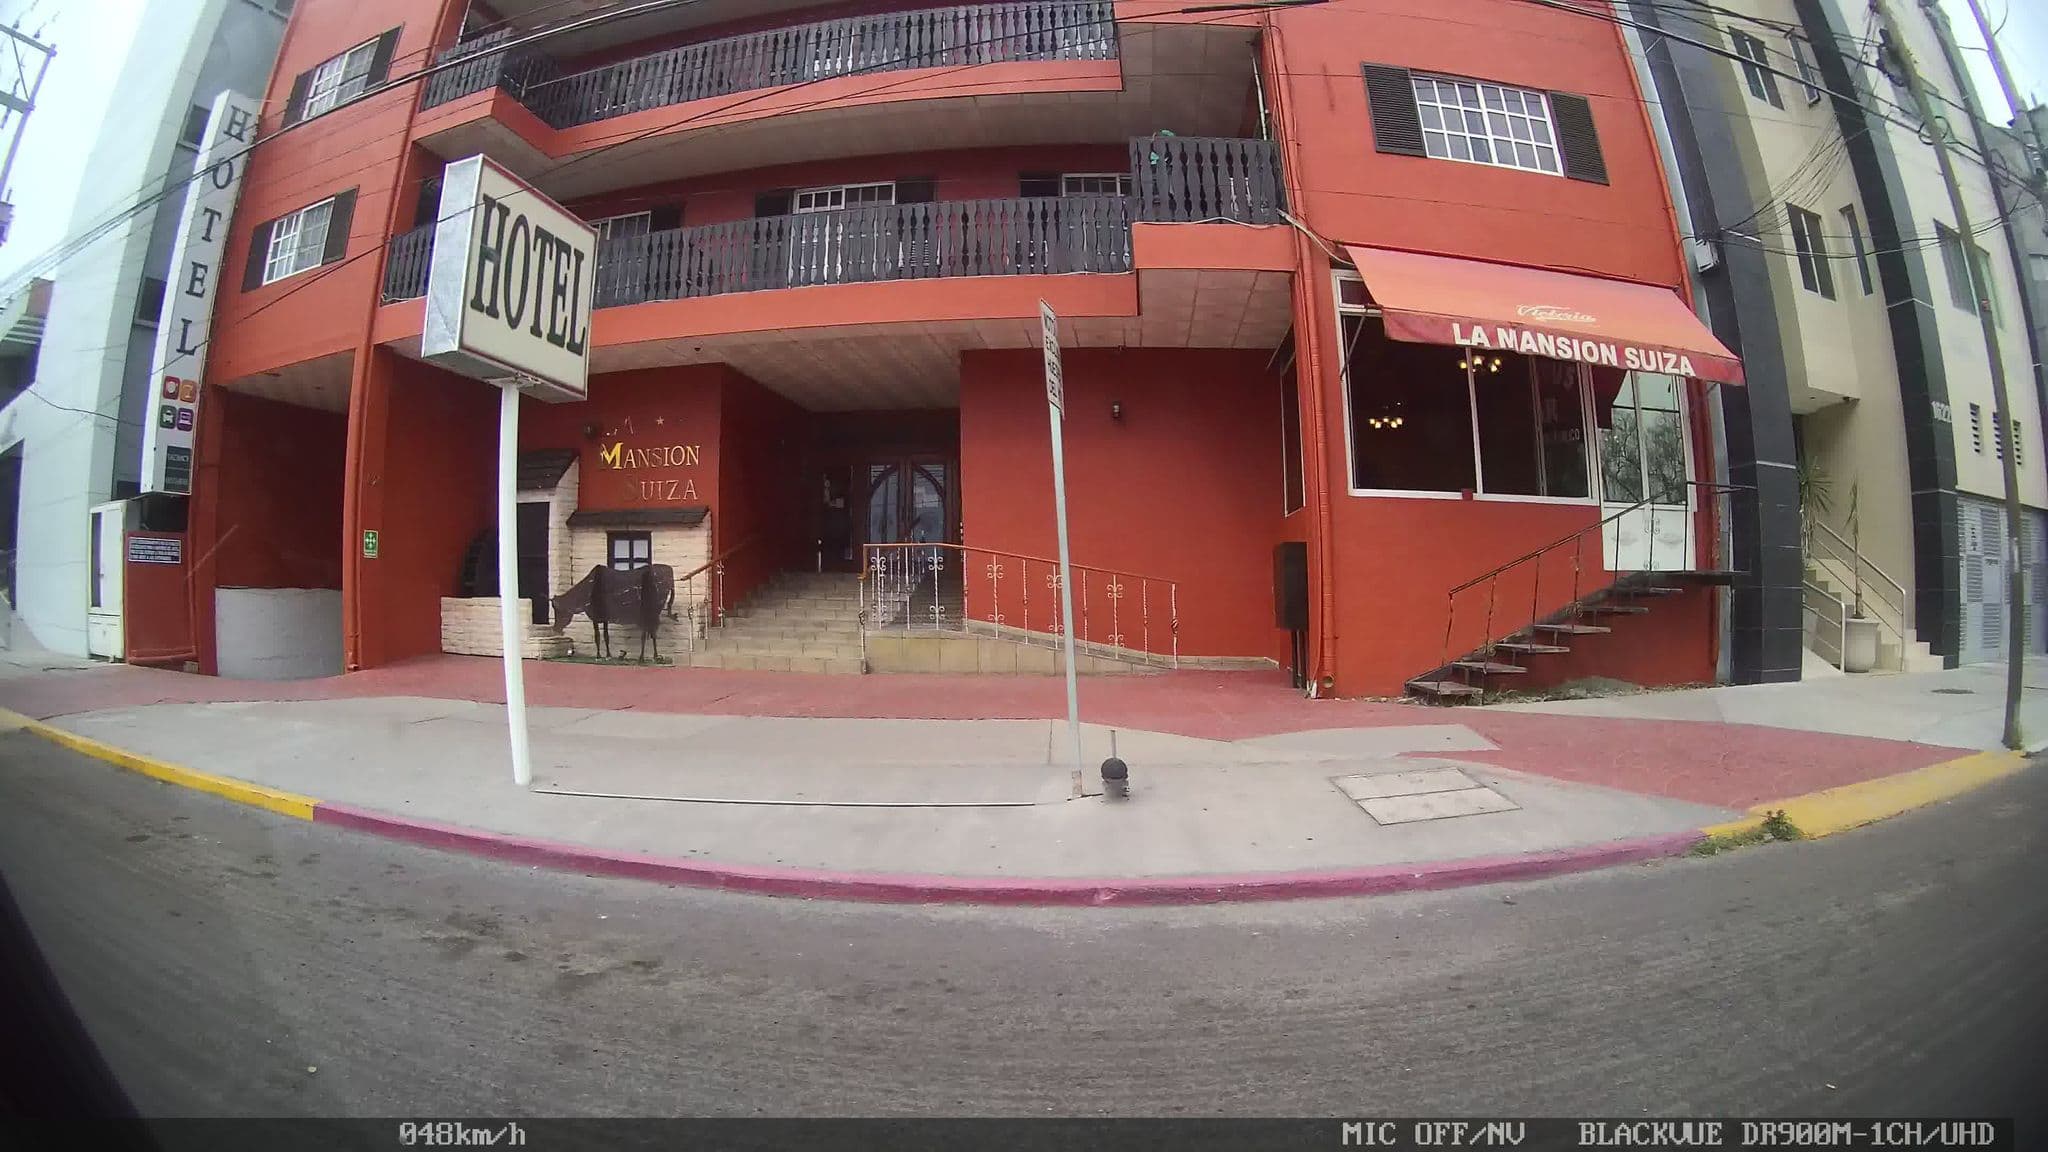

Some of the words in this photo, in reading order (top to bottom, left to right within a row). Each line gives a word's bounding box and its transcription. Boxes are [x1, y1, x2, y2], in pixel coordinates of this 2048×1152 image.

[176, 105, 251, 357] HOTEL
[470, 194, 587, 356] HOTEL
[1453, 323, 1490, 348] LA
[1497, 327, 1618, 367] MANSION
[1624, 347, 1696, 378] SUIZA
[600, 442, 700, 469] MANSION
